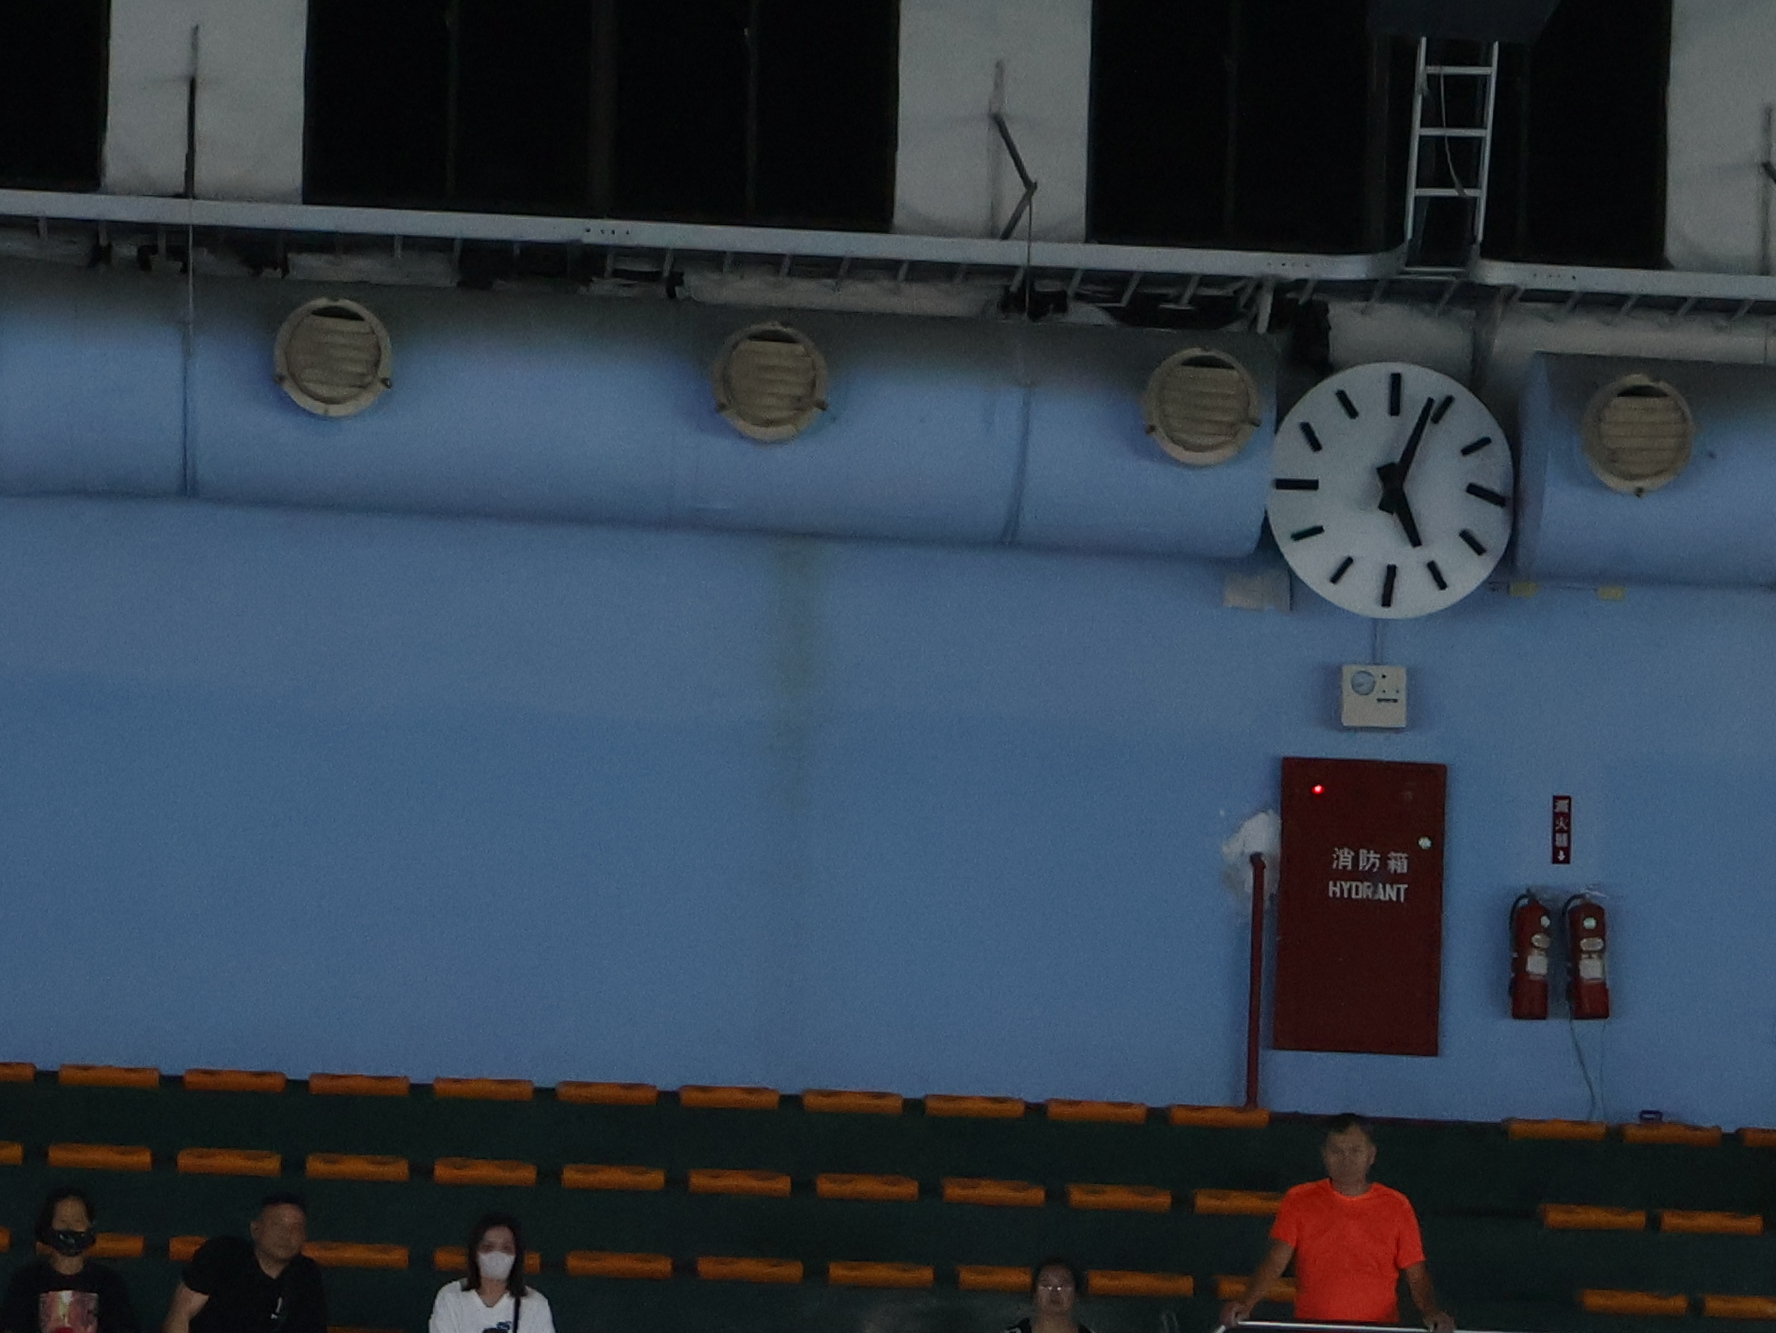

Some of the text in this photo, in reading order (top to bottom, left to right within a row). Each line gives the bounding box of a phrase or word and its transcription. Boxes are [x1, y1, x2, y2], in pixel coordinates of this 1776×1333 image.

[1331, 846, 1409, 874] 消防箱
[1328, 880, 1409, 904] HYDRANT
